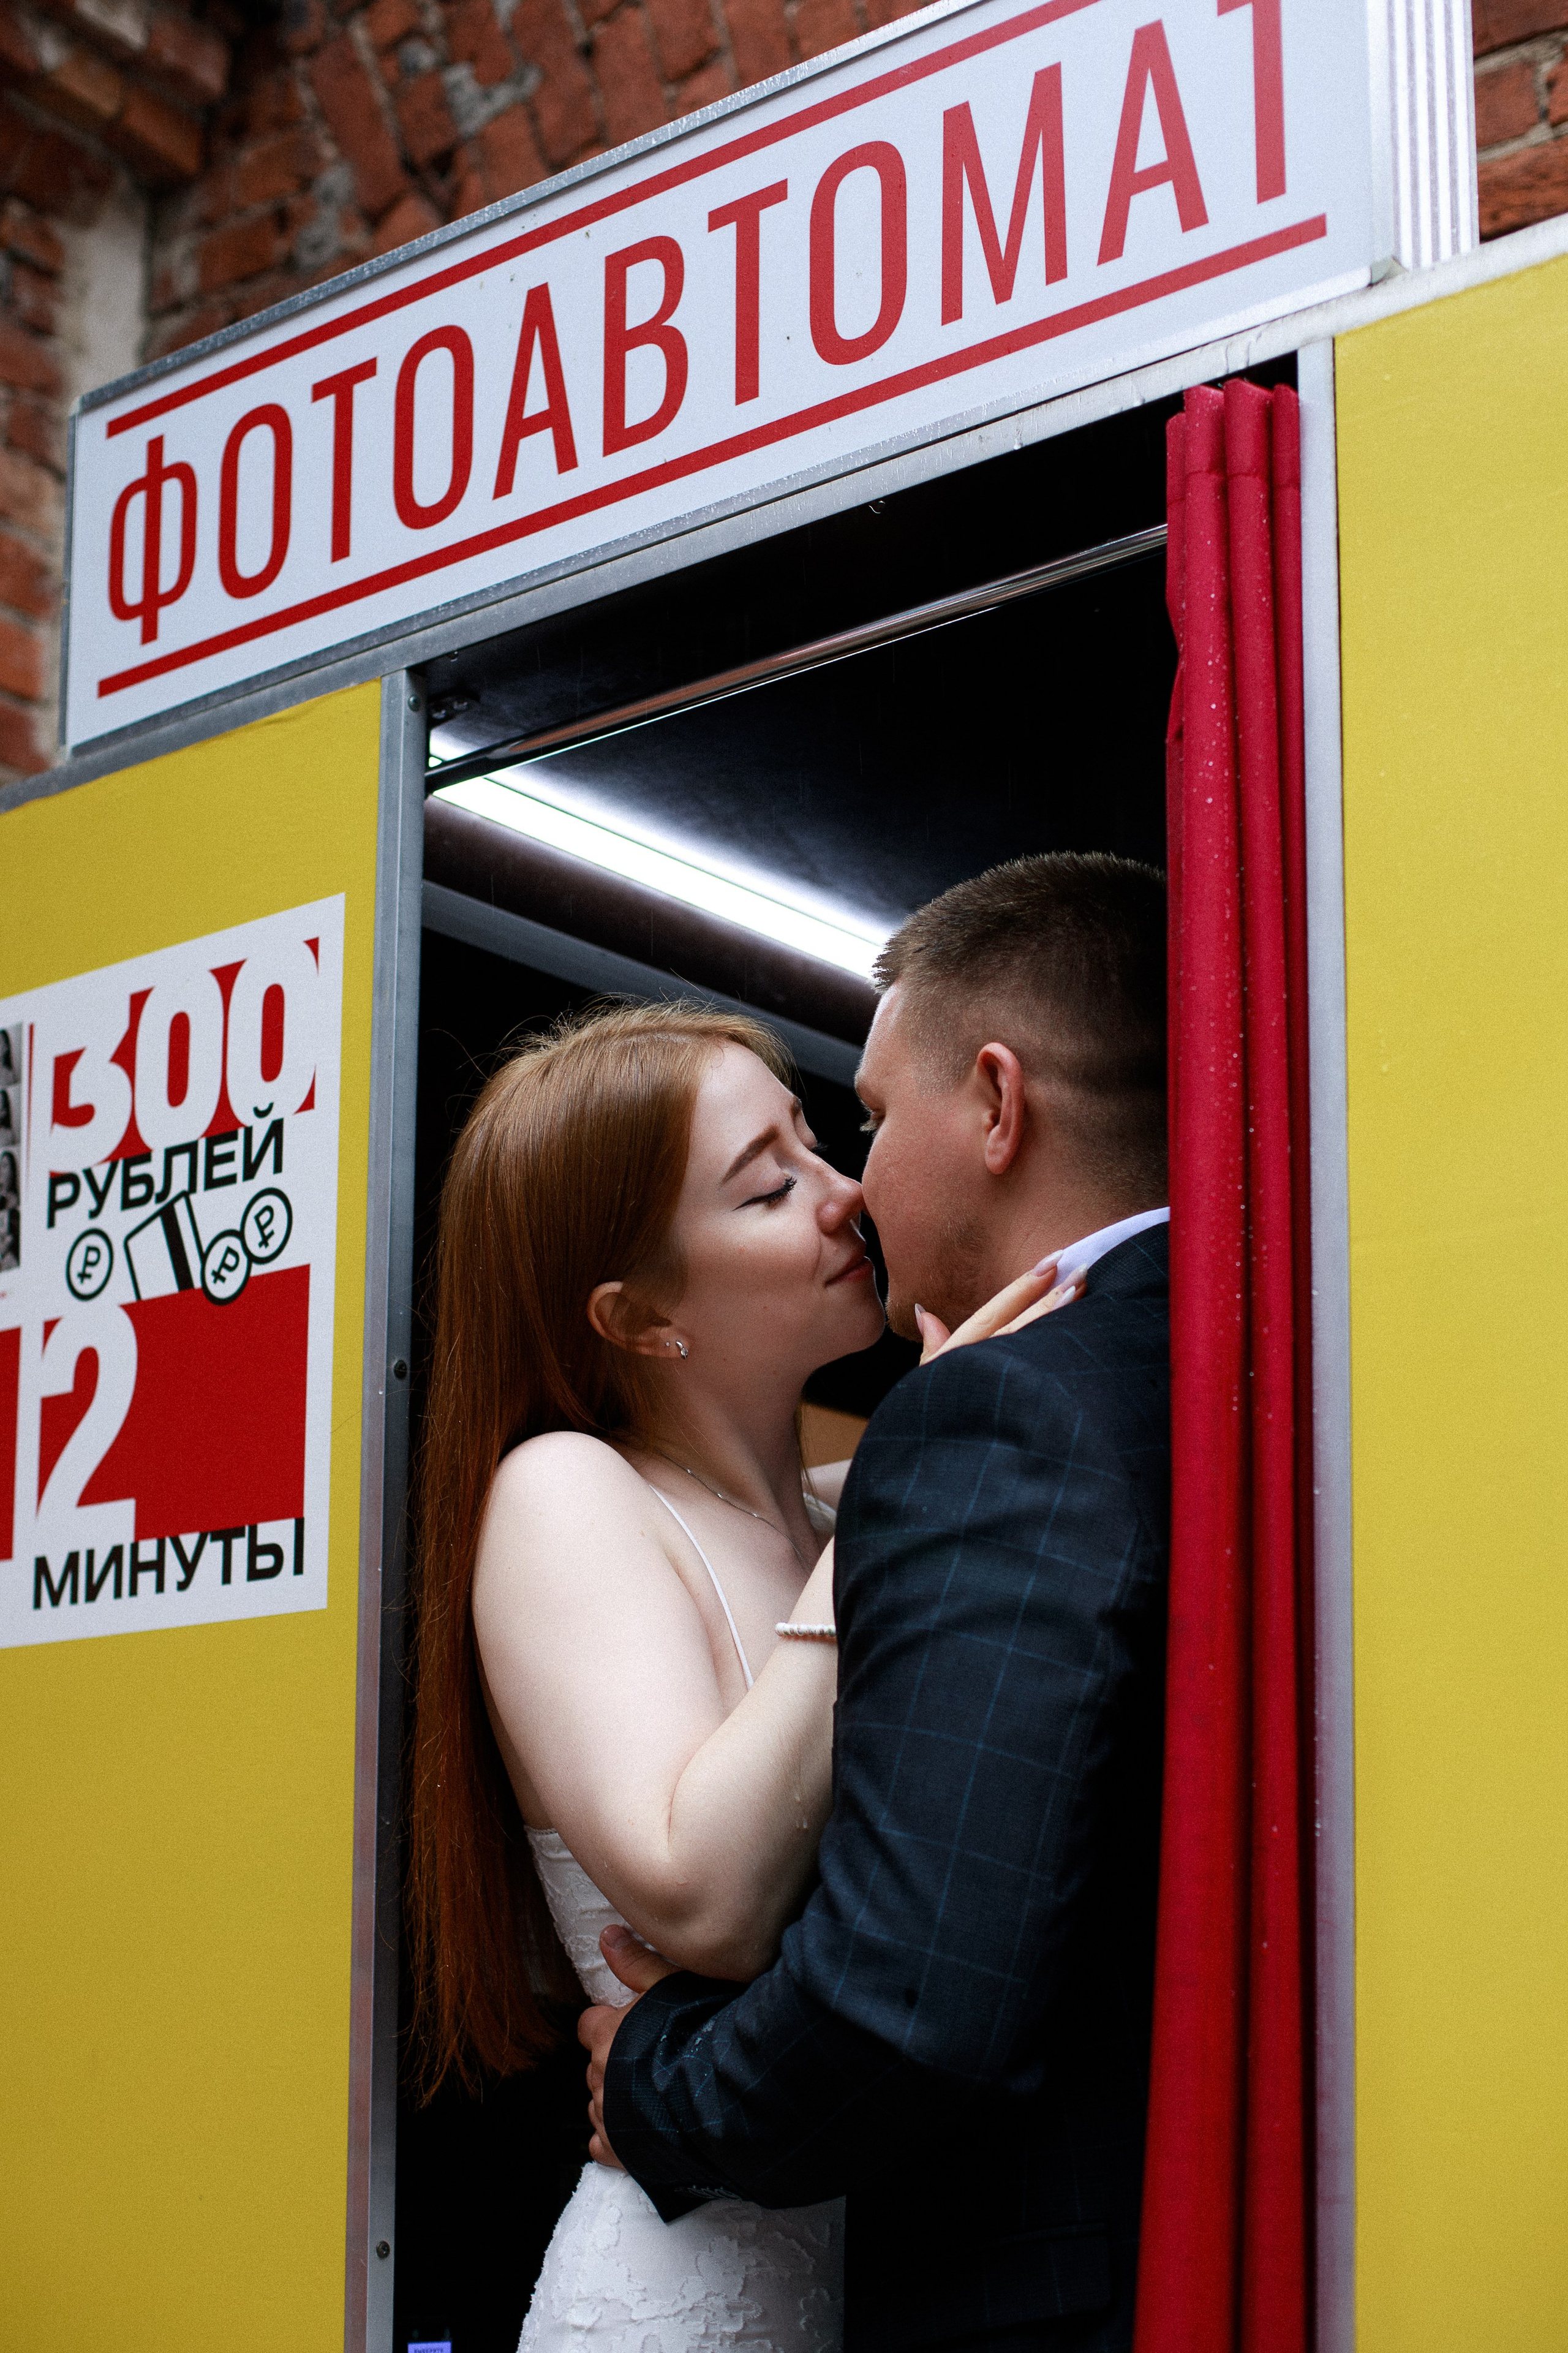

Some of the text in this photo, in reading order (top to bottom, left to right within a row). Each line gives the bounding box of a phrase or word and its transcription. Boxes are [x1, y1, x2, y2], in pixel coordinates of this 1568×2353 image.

[108, 0, 1287, 646] ФОТОАВТОМАТ
[47, 1102, 284, 1229] РУБЛЕЙ
[50, 942, 317, 1173] 300
[37, 1299, 137, 1556] 2
[33, 1516, 305, 1611] МИНУТЫ
